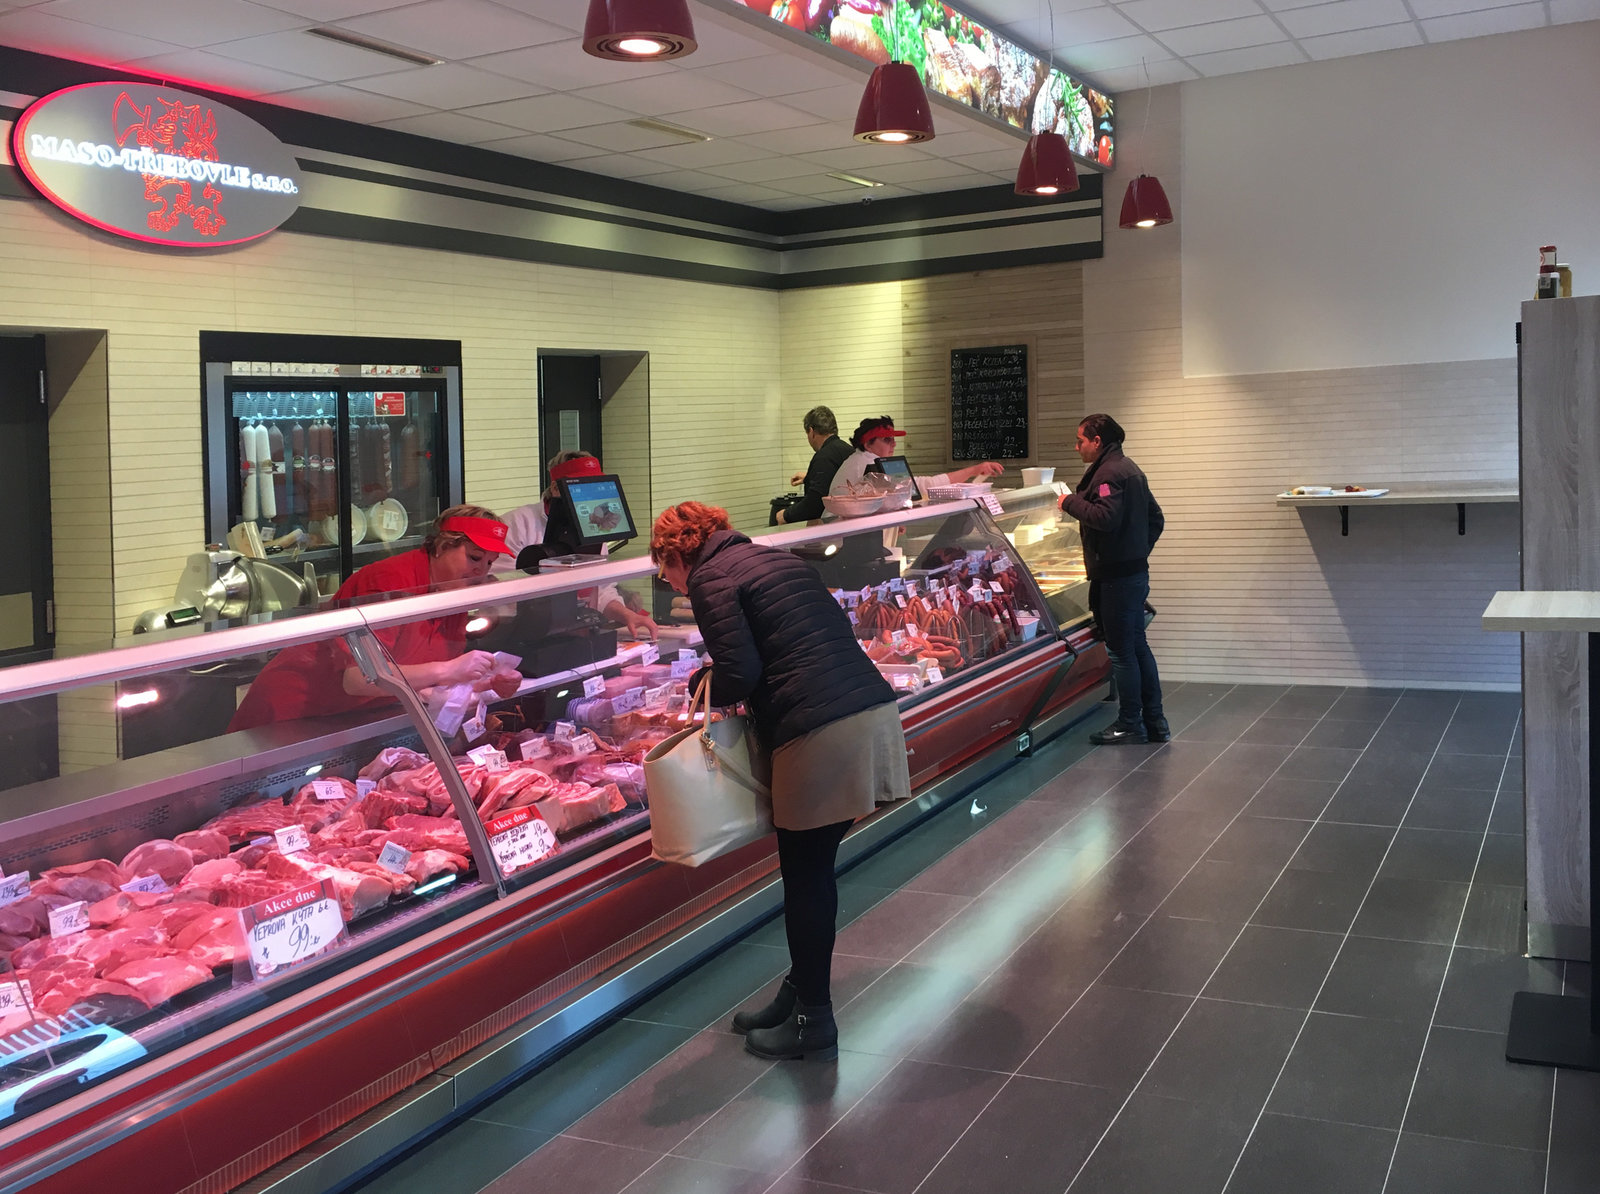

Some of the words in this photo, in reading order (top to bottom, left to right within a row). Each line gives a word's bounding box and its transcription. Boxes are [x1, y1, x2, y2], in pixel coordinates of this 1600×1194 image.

[31, 134, 250, 188] MASO-TŘEBOVLE
[252, 173, 298, 194] s.r.o.
[493, 818, 512, 831] Akce
[513, 813, 528, 823] dne
[264, 901, 292, 916] Akce
[295, 890, 316, 903] dne
